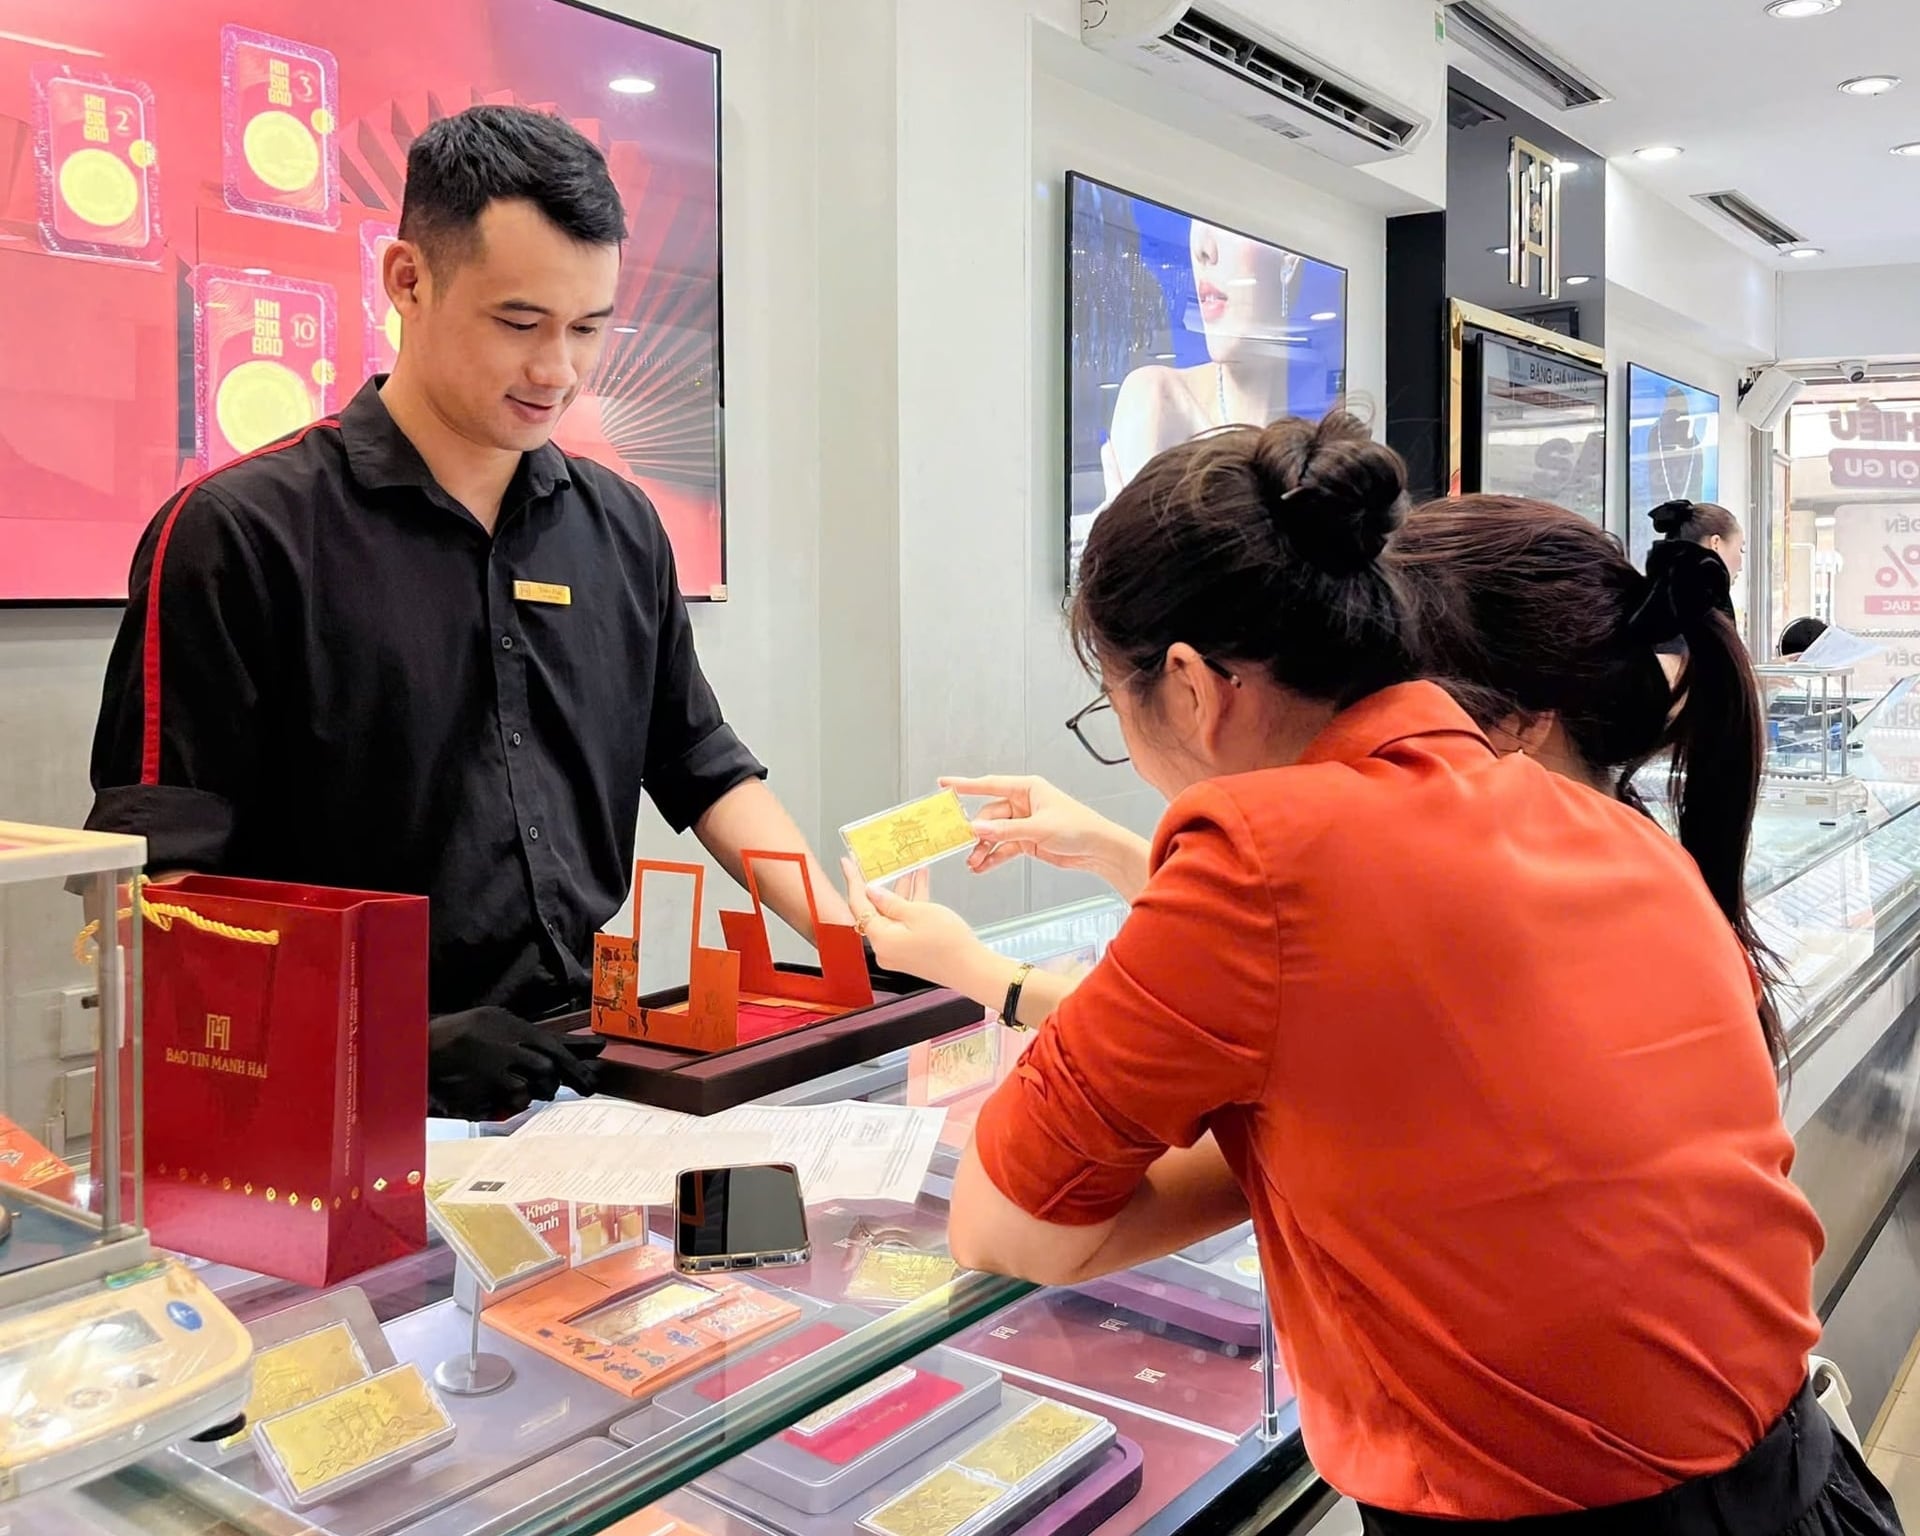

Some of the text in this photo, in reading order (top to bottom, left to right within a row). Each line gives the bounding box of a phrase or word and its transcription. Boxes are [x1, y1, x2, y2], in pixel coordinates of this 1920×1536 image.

[299, 74, 313, 97] 3
[114, 110, 130, 132] 2
[293, 319, 316, 342] 10
